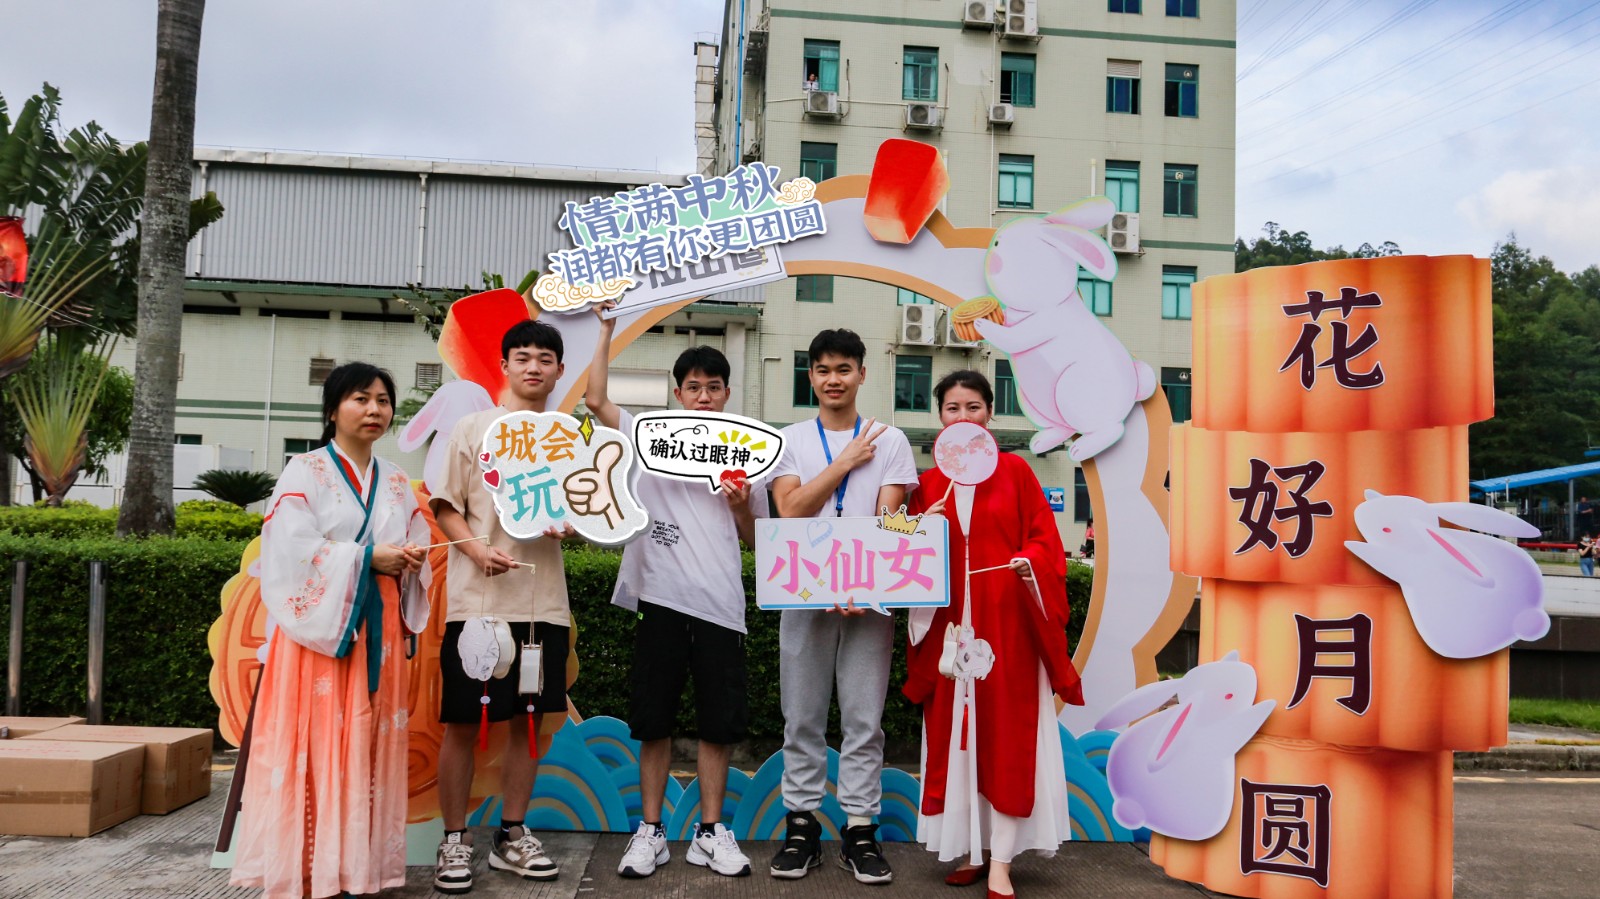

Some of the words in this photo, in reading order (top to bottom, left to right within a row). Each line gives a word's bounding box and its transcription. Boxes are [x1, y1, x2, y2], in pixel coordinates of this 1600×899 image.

[559, 163, 781, 245] 情满中秋
[551, 202, 824, 284] 润都有你更团圆
[495, 420, 580, 463] 城会
[505, 466, 565, 522] 玩
[767, 537, 936, 594] 小仙女
[1229, 288, 1385, 888] 花好月圆
